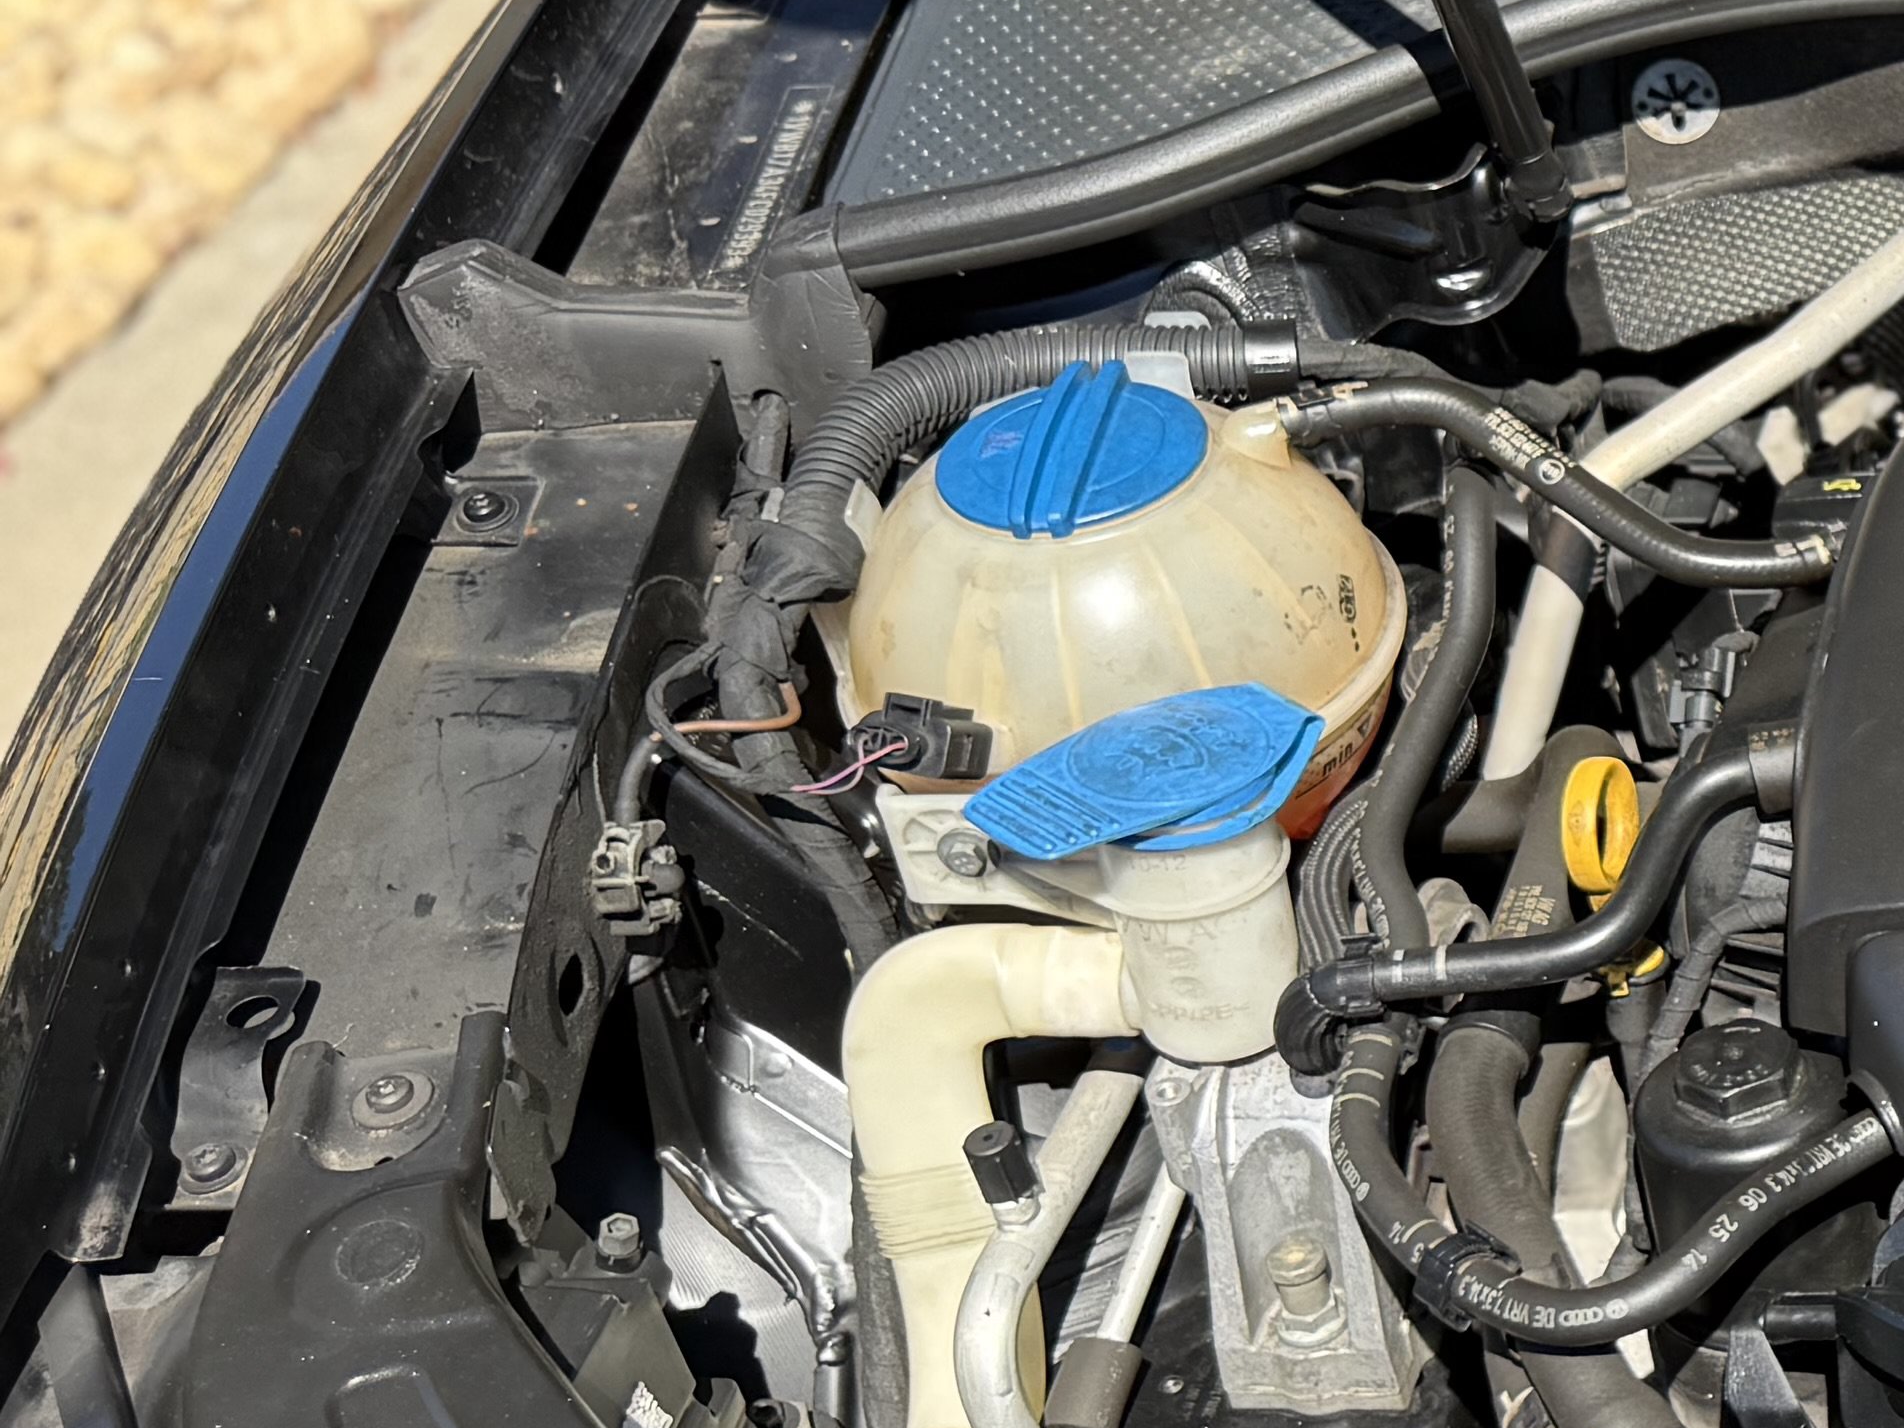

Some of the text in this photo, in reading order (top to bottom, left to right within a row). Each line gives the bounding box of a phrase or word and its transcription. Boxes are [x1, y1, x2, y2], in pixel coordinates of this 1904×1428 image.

[1322, 741, 1354, 777] min
[1709, 1213, 1739, 1243] 25
[1532, 1310, 1555, 1330] DE
